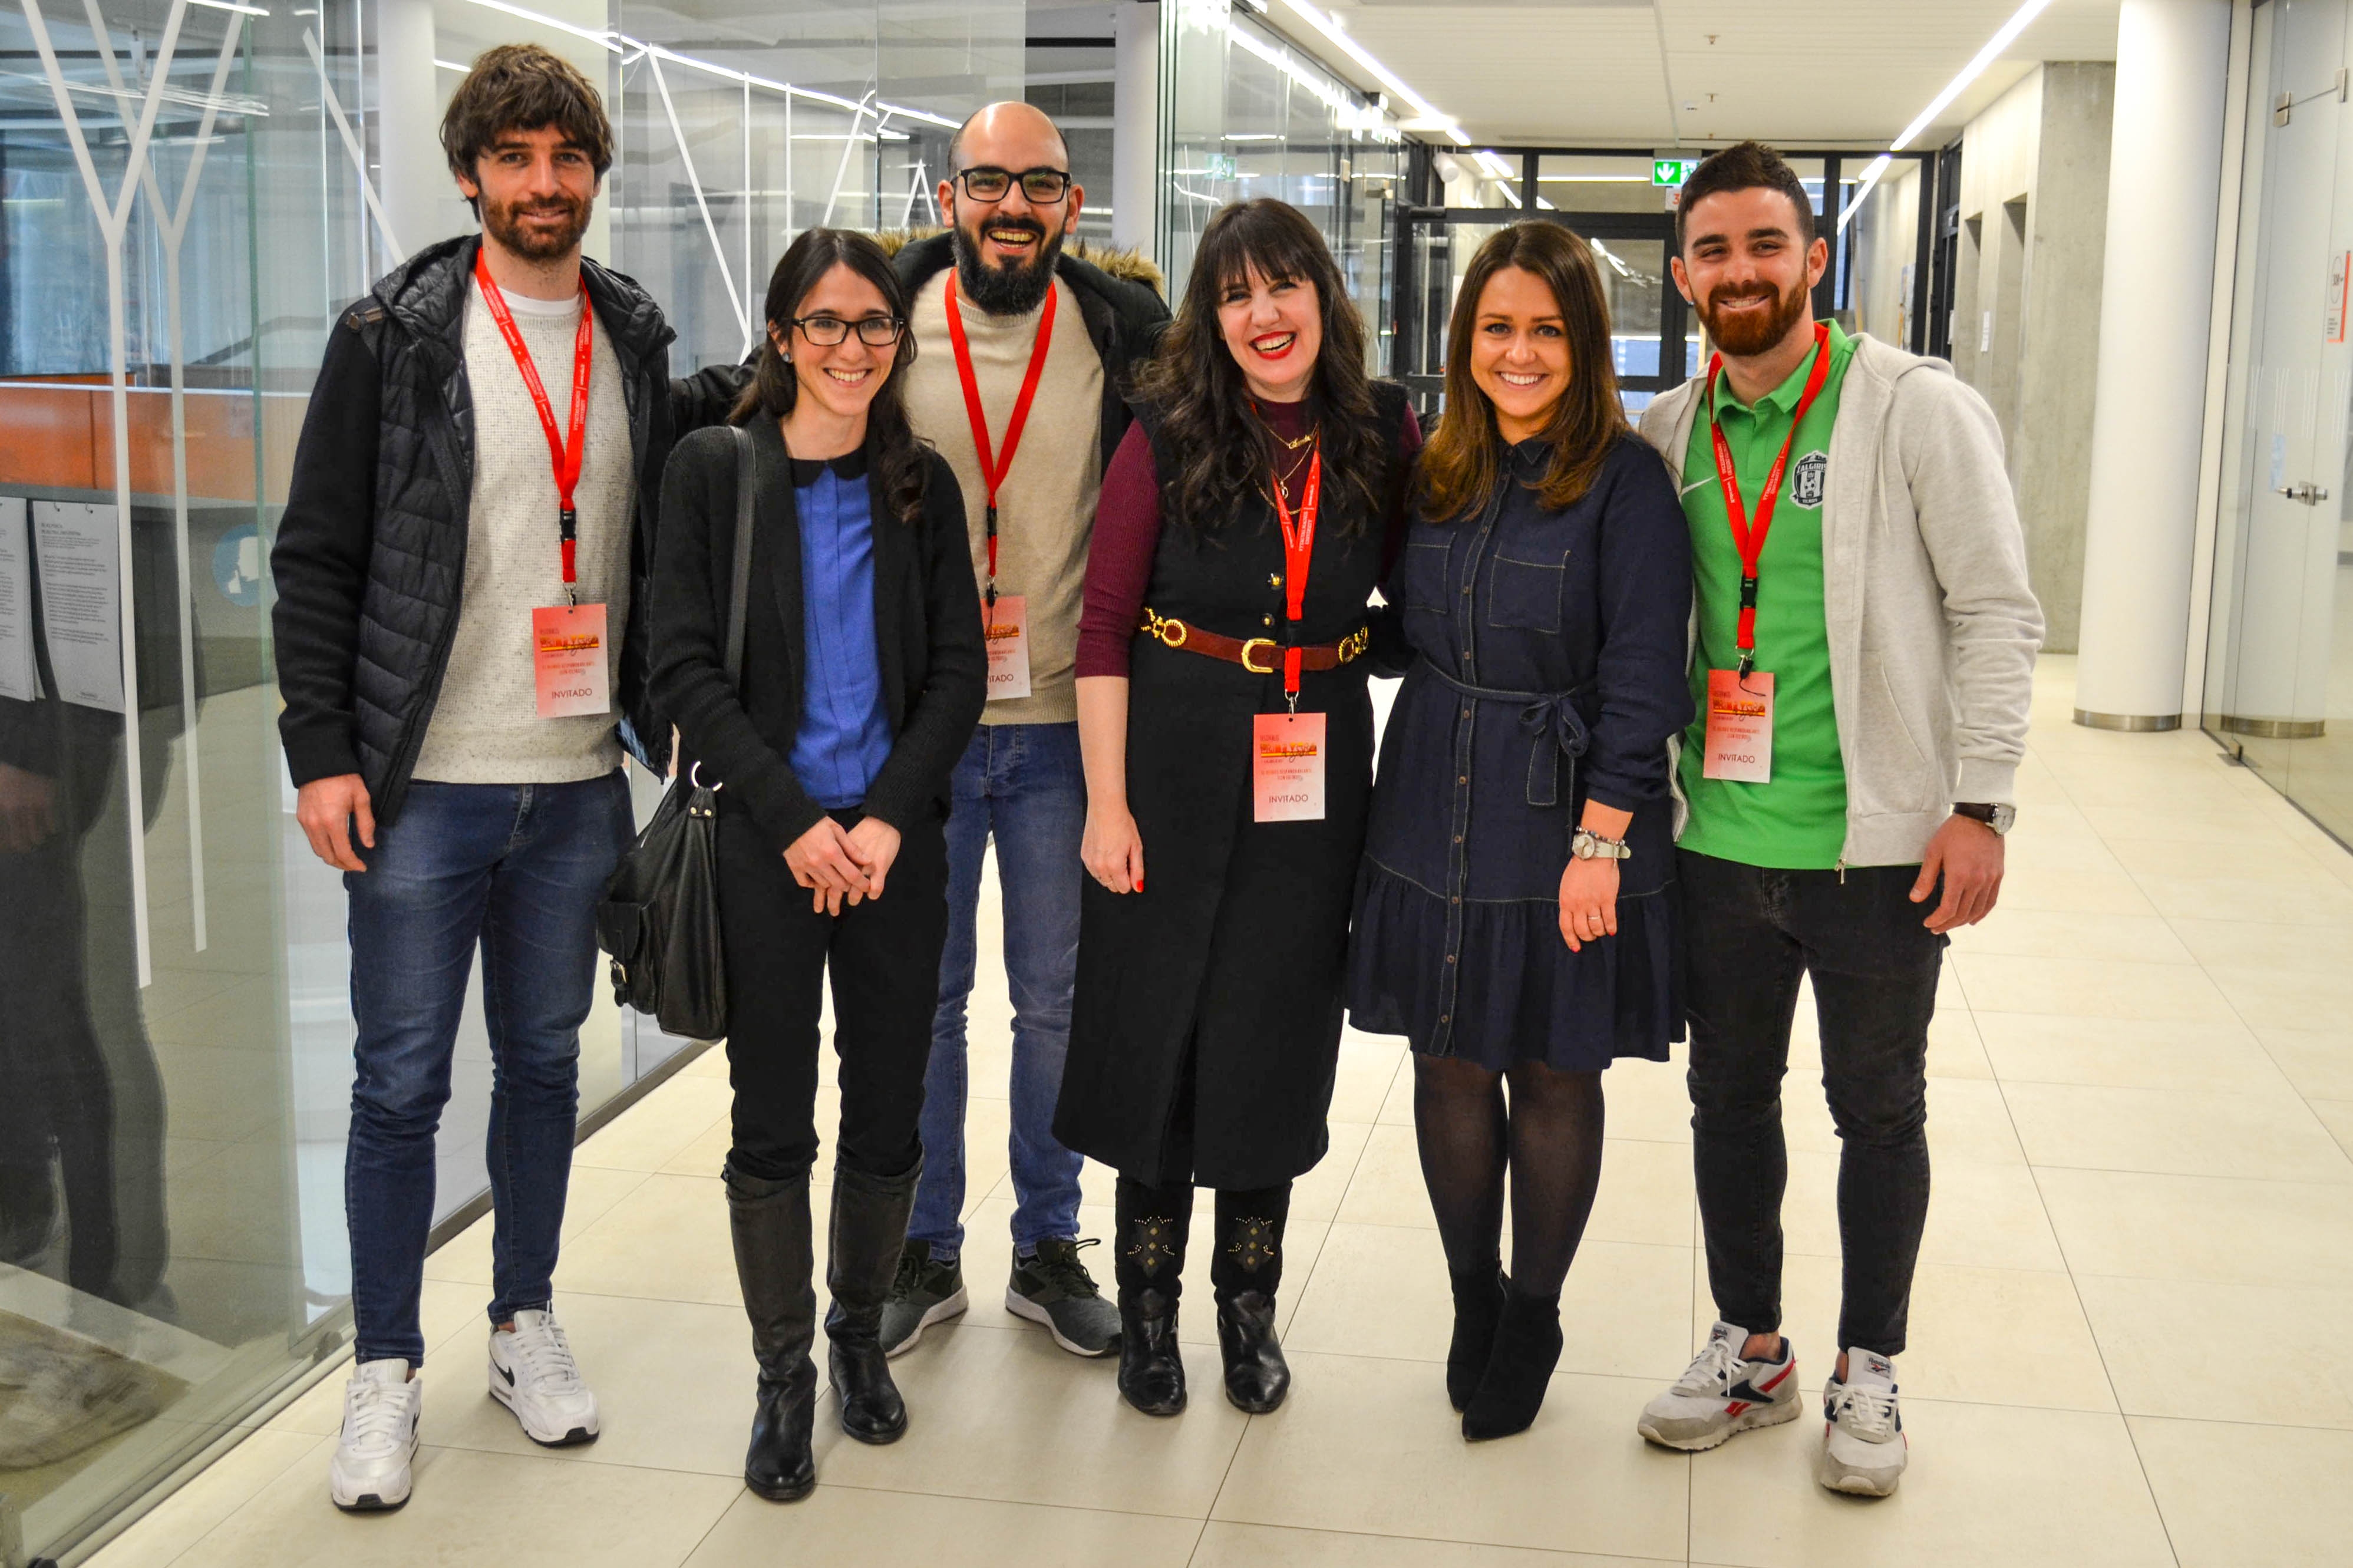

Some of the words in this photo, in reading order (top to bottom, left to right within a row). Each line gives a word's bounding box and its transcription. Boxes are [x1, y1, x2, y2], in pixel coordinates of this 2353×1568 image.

[1672, 193, 1680, 204] 3
[989, 674, 1014, 683] ITADO
[552, 688, 592, 699] INVITADO
[1718, 754, 1755, 763] INVITADO
[1269, 795, 1308, 803] INVITADO
